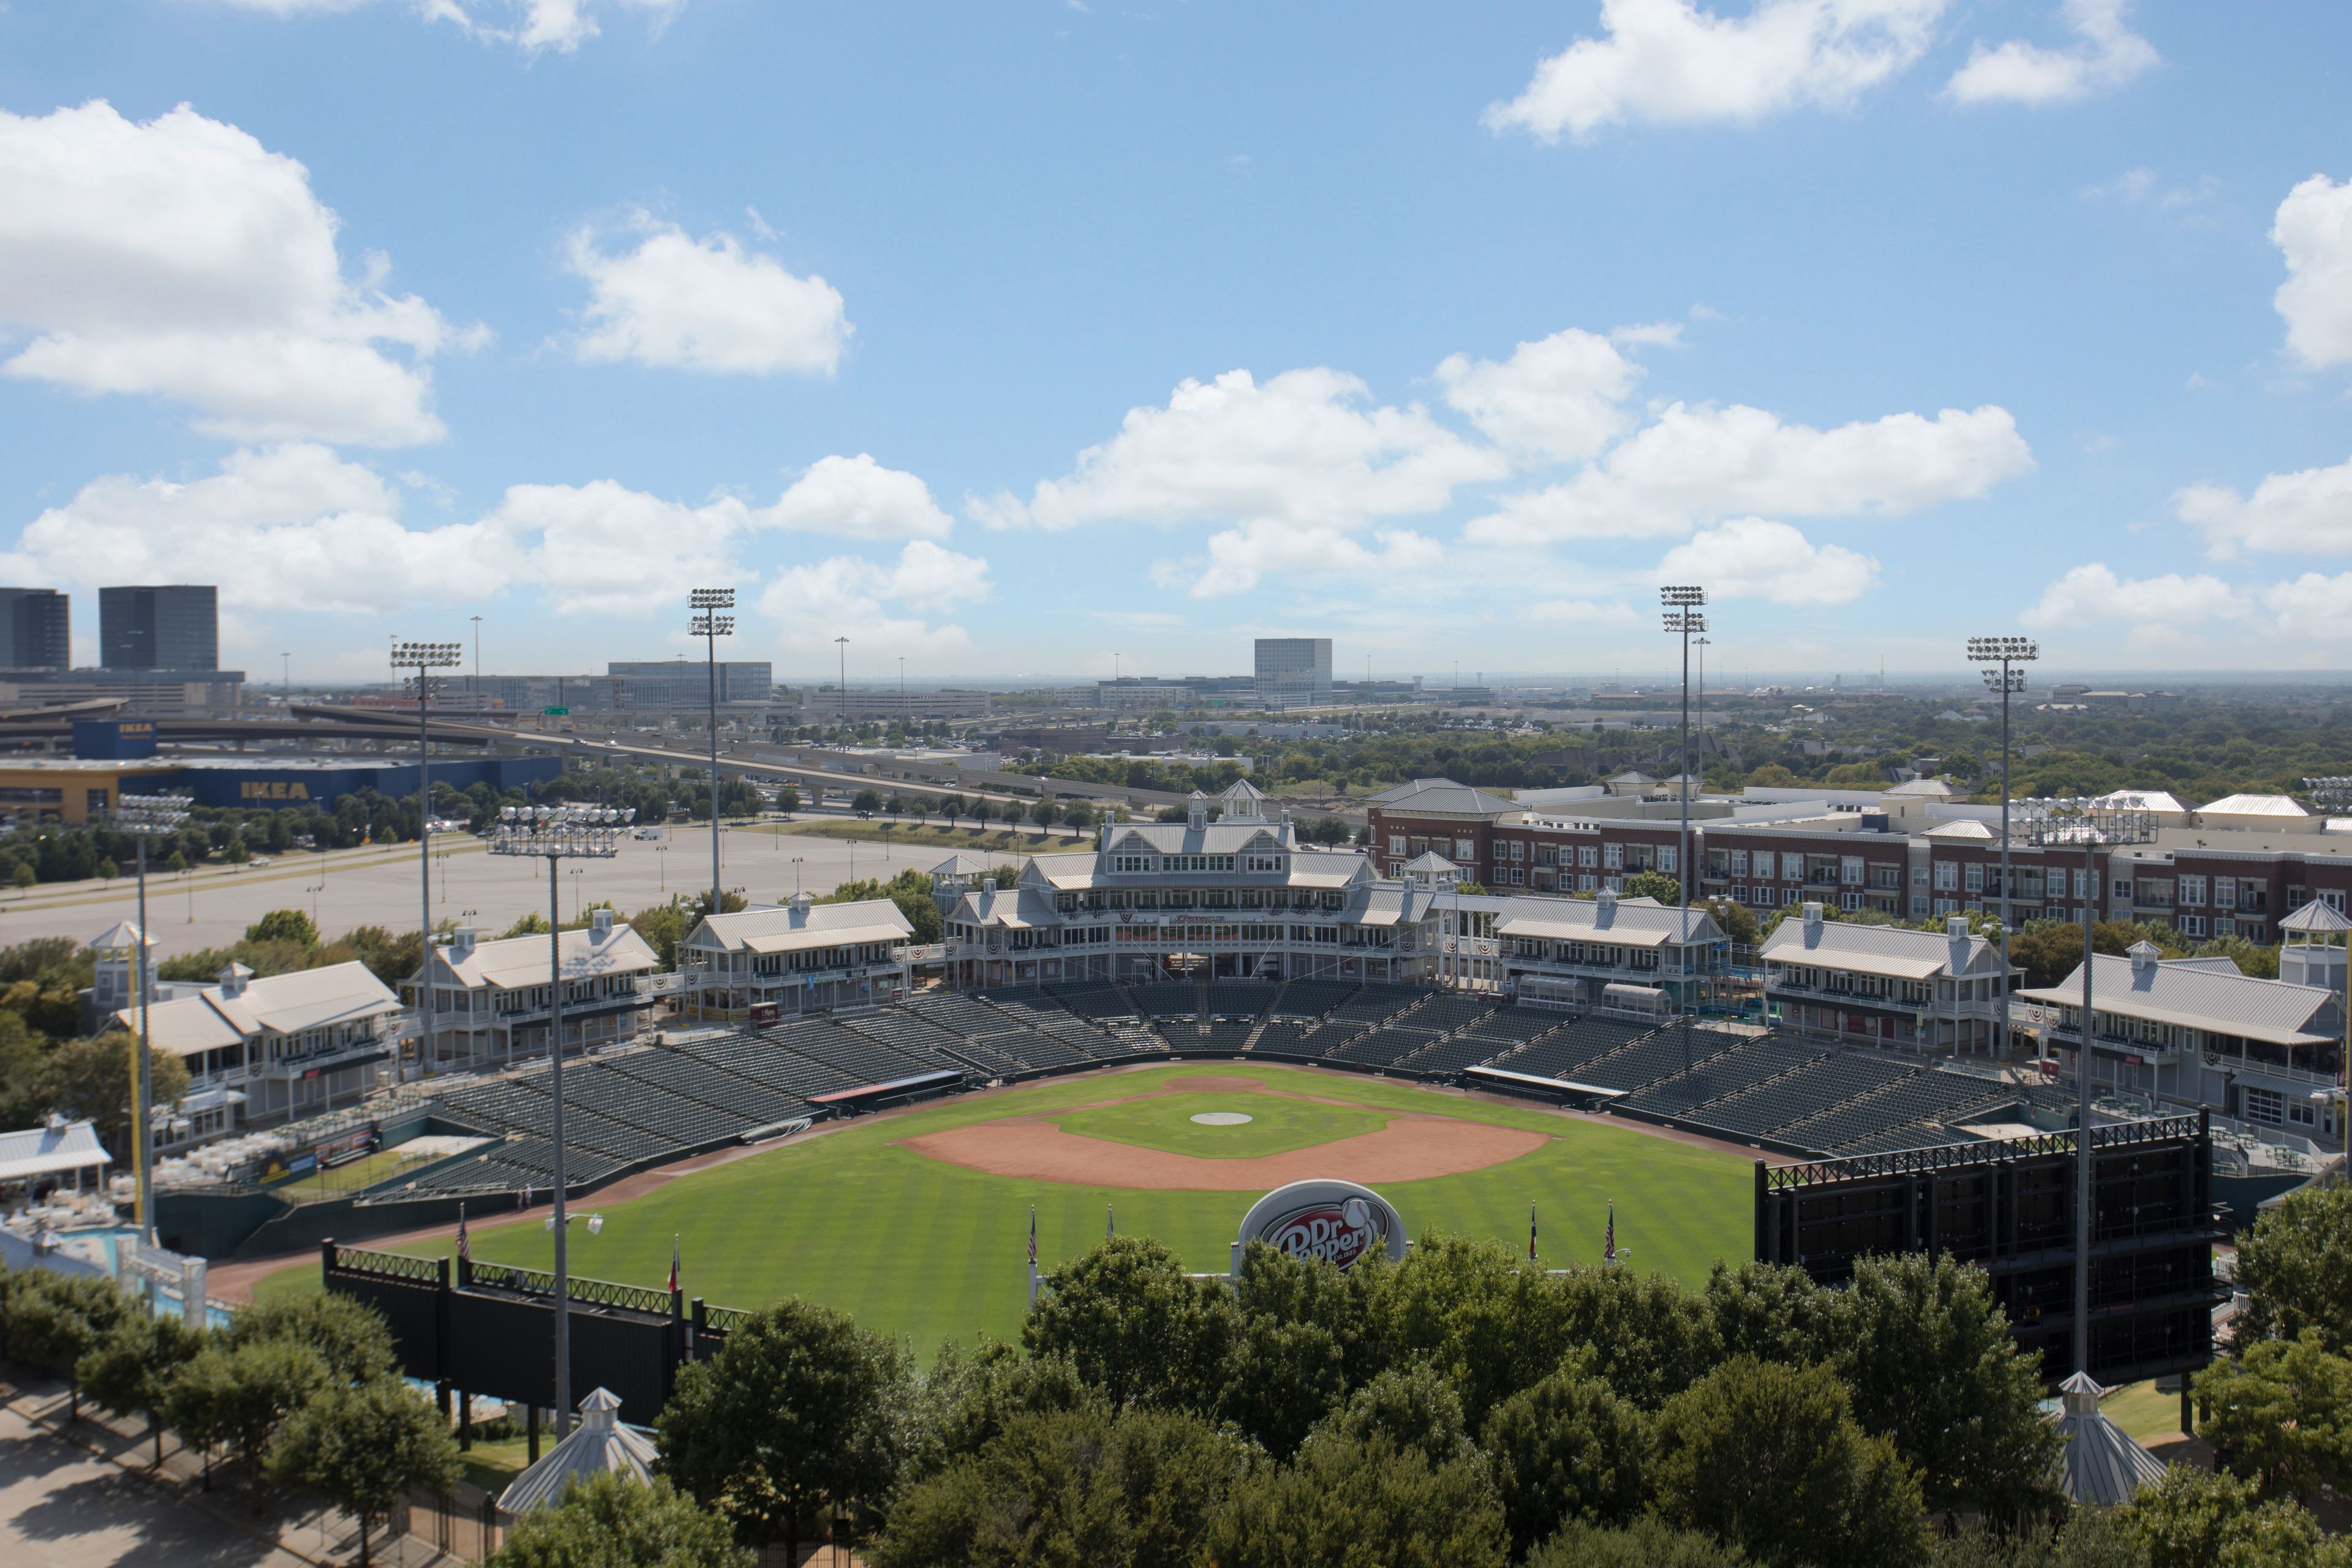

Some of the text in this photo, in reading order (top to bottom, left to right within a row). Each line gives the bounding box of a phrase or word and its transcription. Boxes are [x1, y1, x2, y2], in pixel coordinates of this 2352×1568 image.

[119, 724, 153, 733] IKEA
[241, 782, 309, 799] IKEA
[1309, 1218, 1343, 1246] Dr
